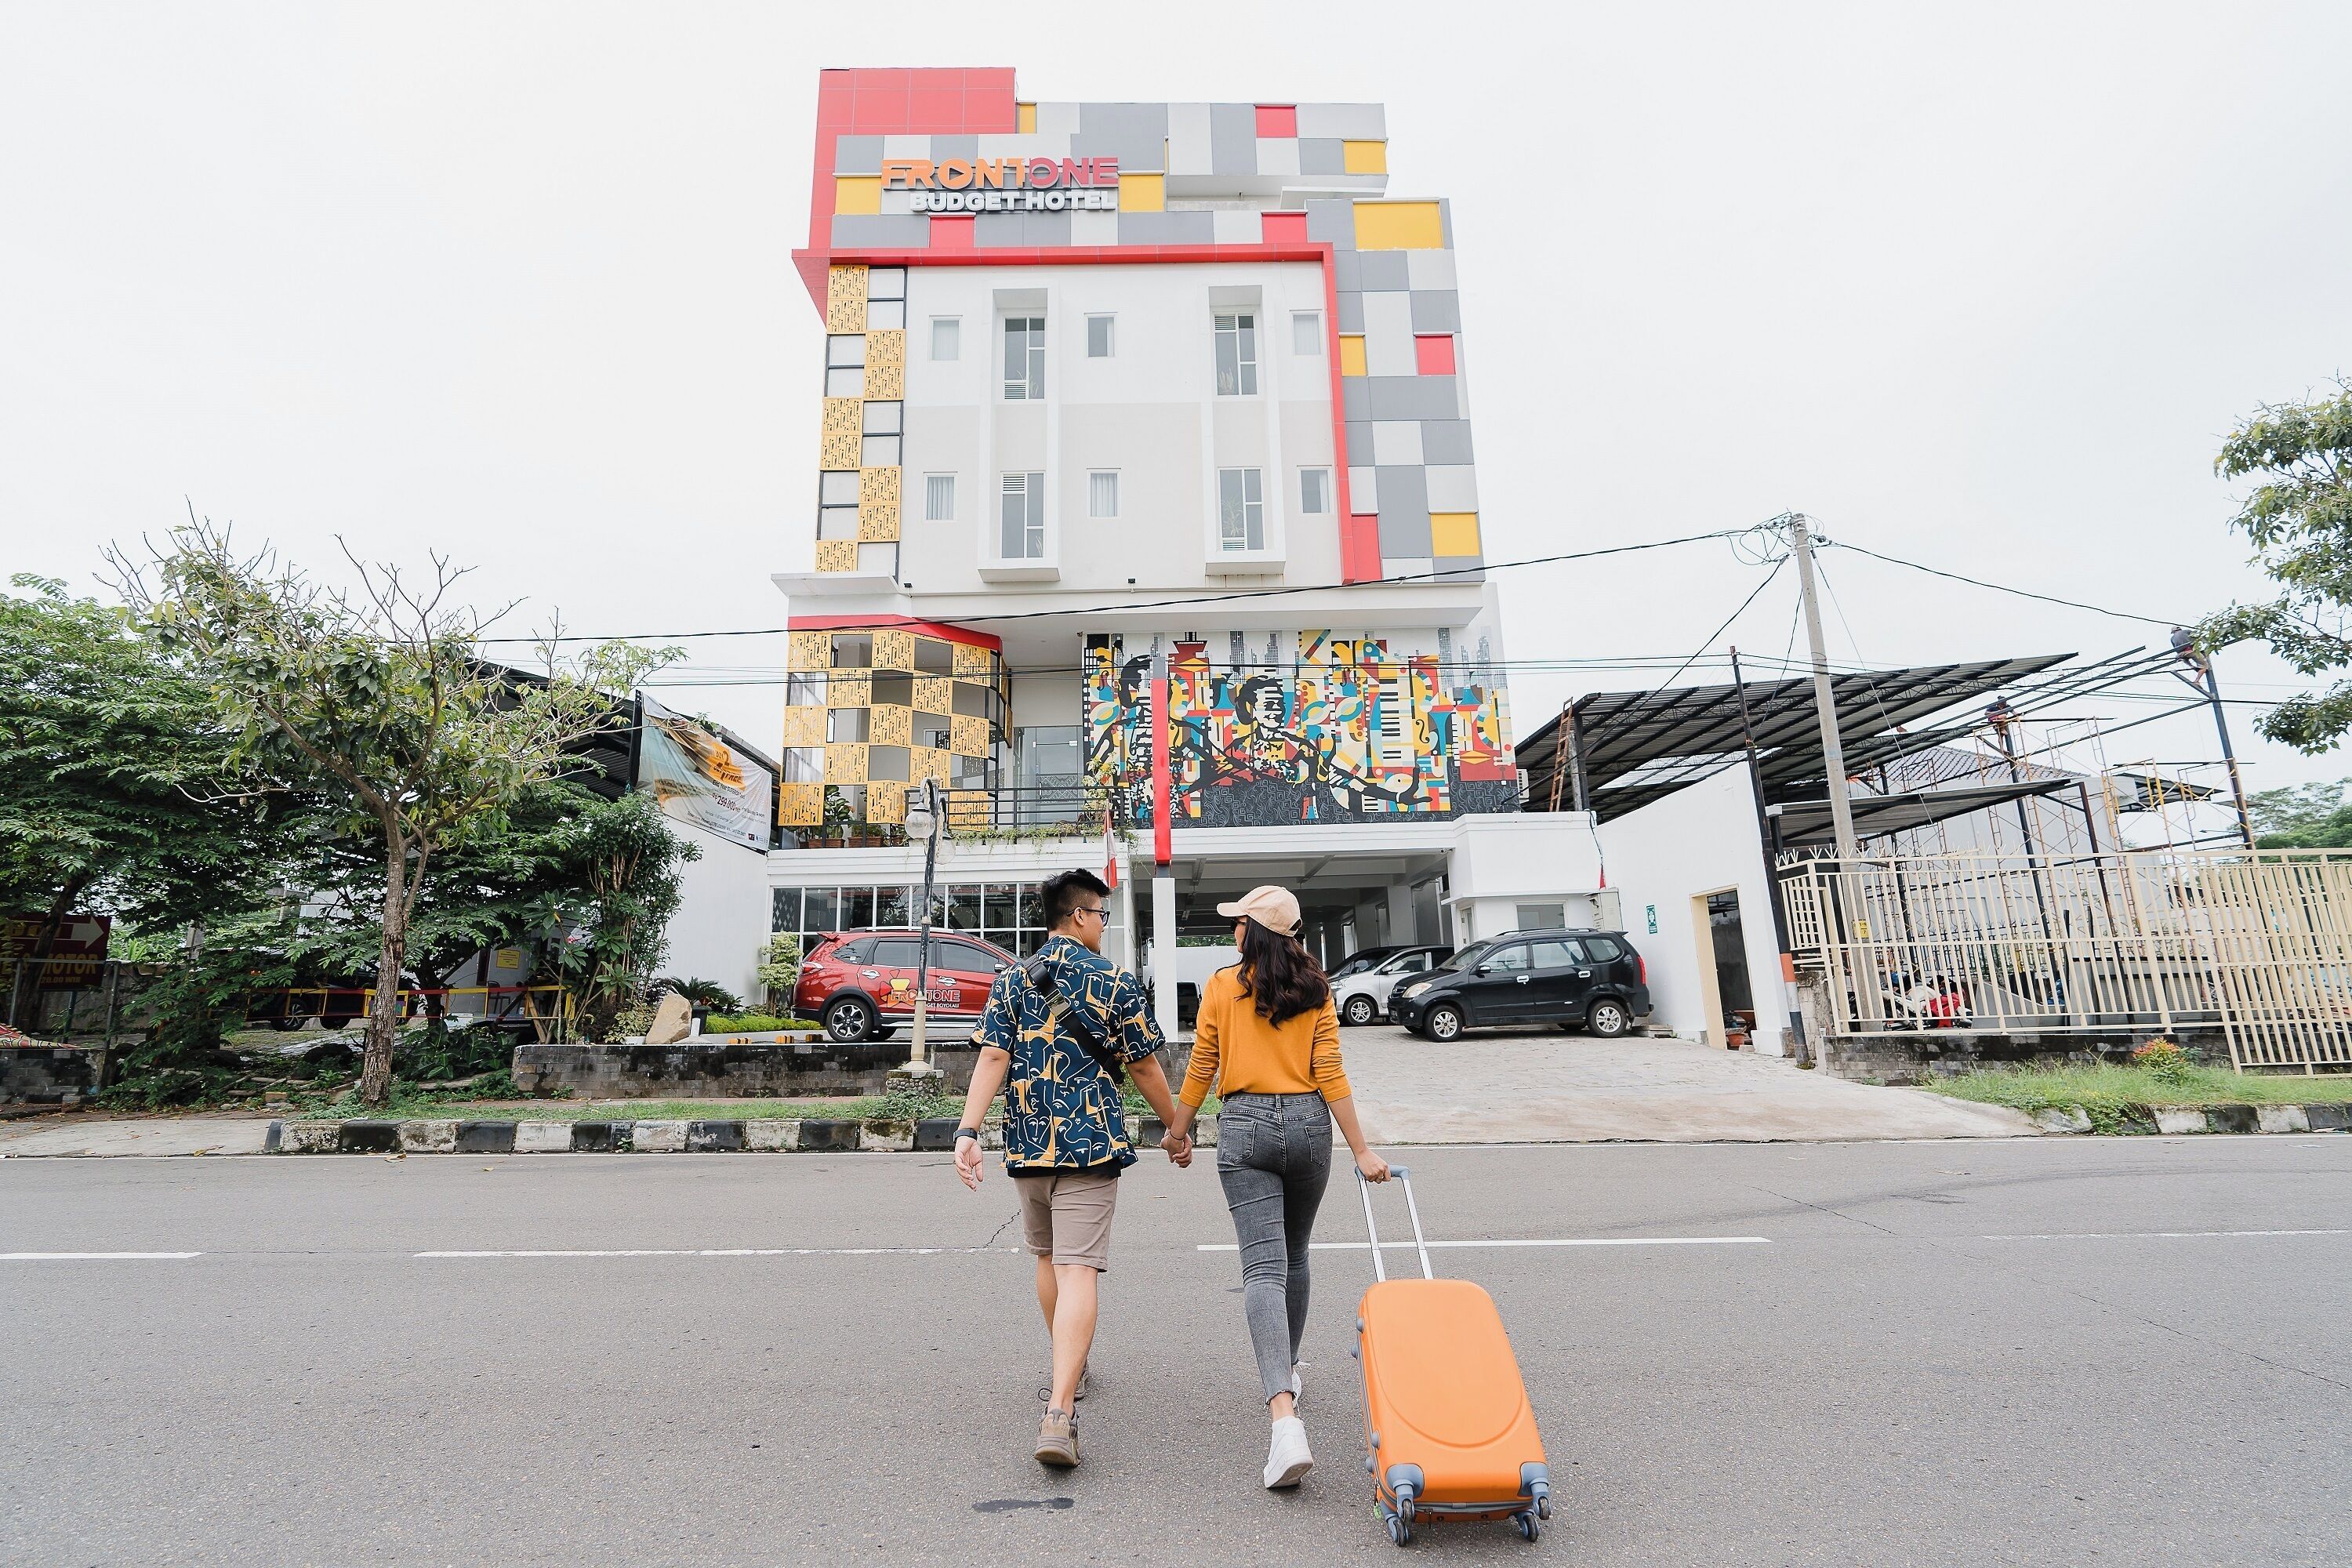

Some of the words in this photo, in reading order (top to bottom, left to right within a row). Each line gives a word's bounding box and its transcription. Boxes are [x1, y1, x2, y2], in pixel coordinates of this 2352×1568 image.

[881, 157, 1119, 190] FRONTONE
[910, 191, 1021, 212] BUDGET
[1025, 191, 1116, 211] HOTEL
[891, 989, 960, 1002] FROTONE
